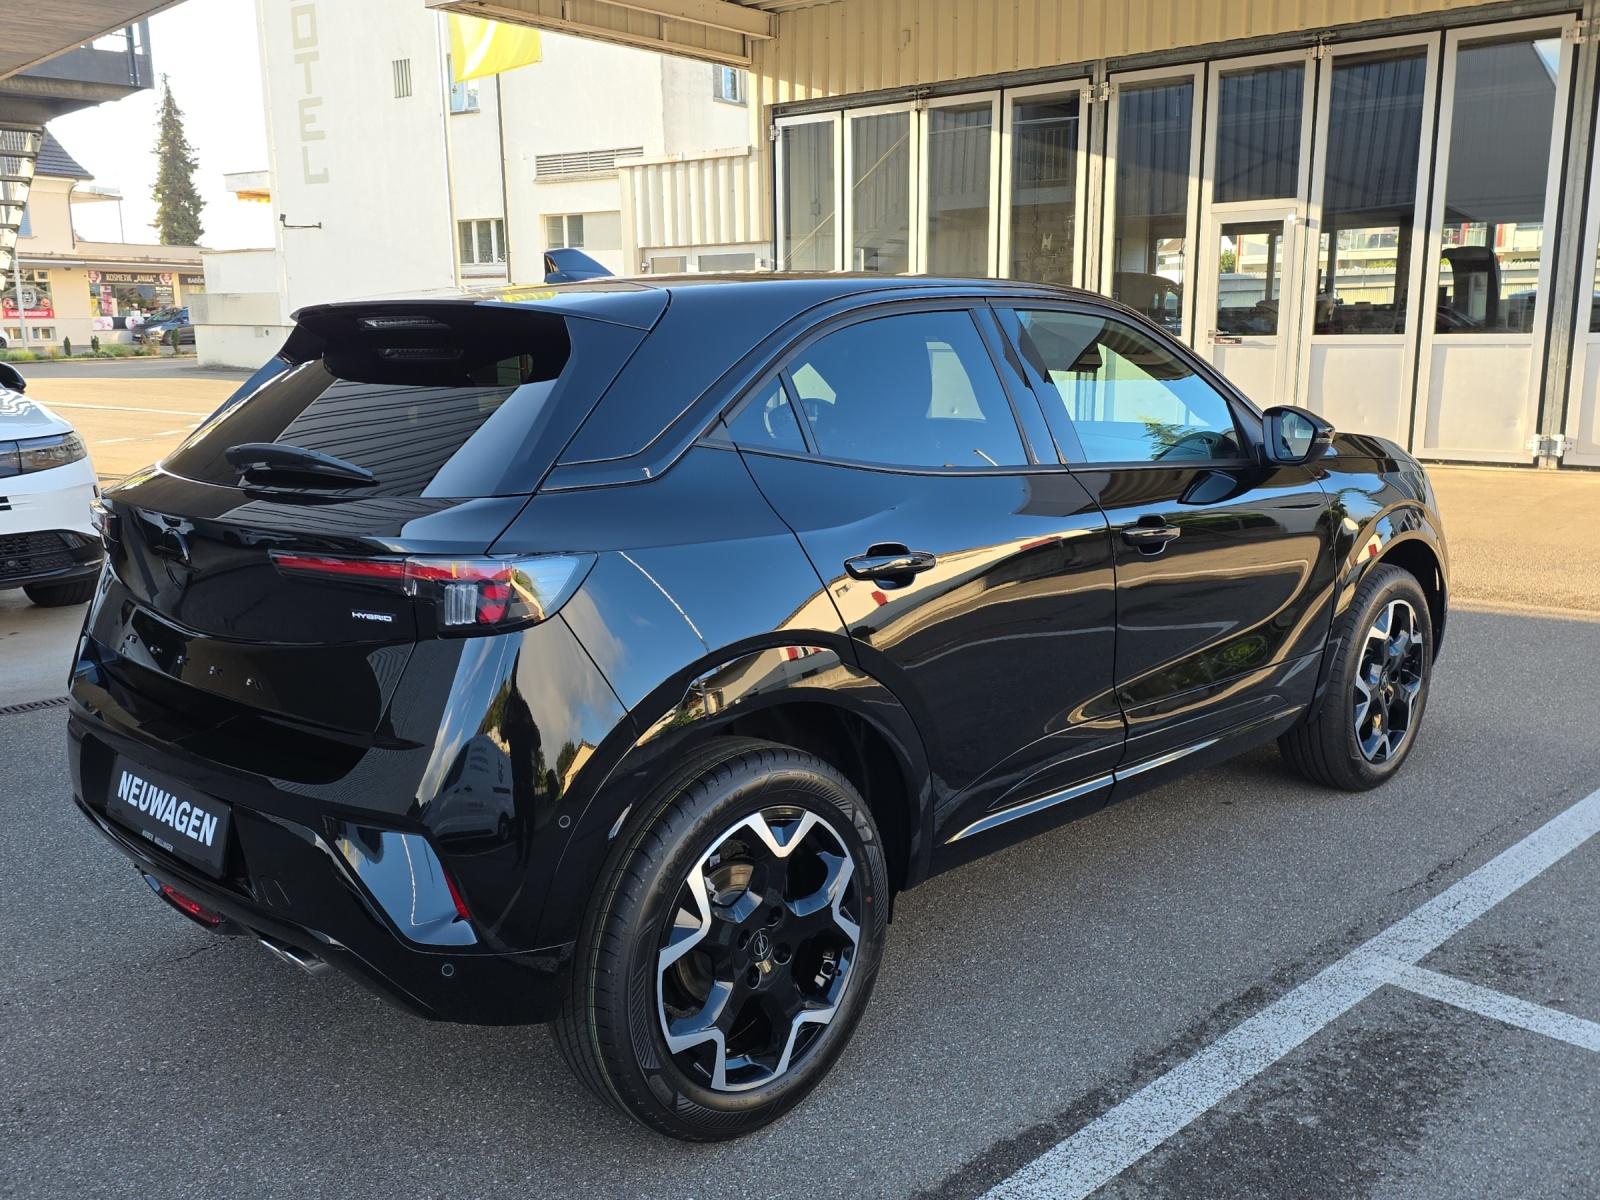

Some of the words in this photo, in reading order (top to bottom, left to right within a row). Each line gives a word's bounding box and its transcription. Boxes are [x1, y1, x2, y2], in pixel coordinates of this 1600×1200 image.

[290, 0, 330, 185] OTEL
[352, 611, 393, 622] HYBRID
[117, 770, 218, 847] NEUWAGEN
